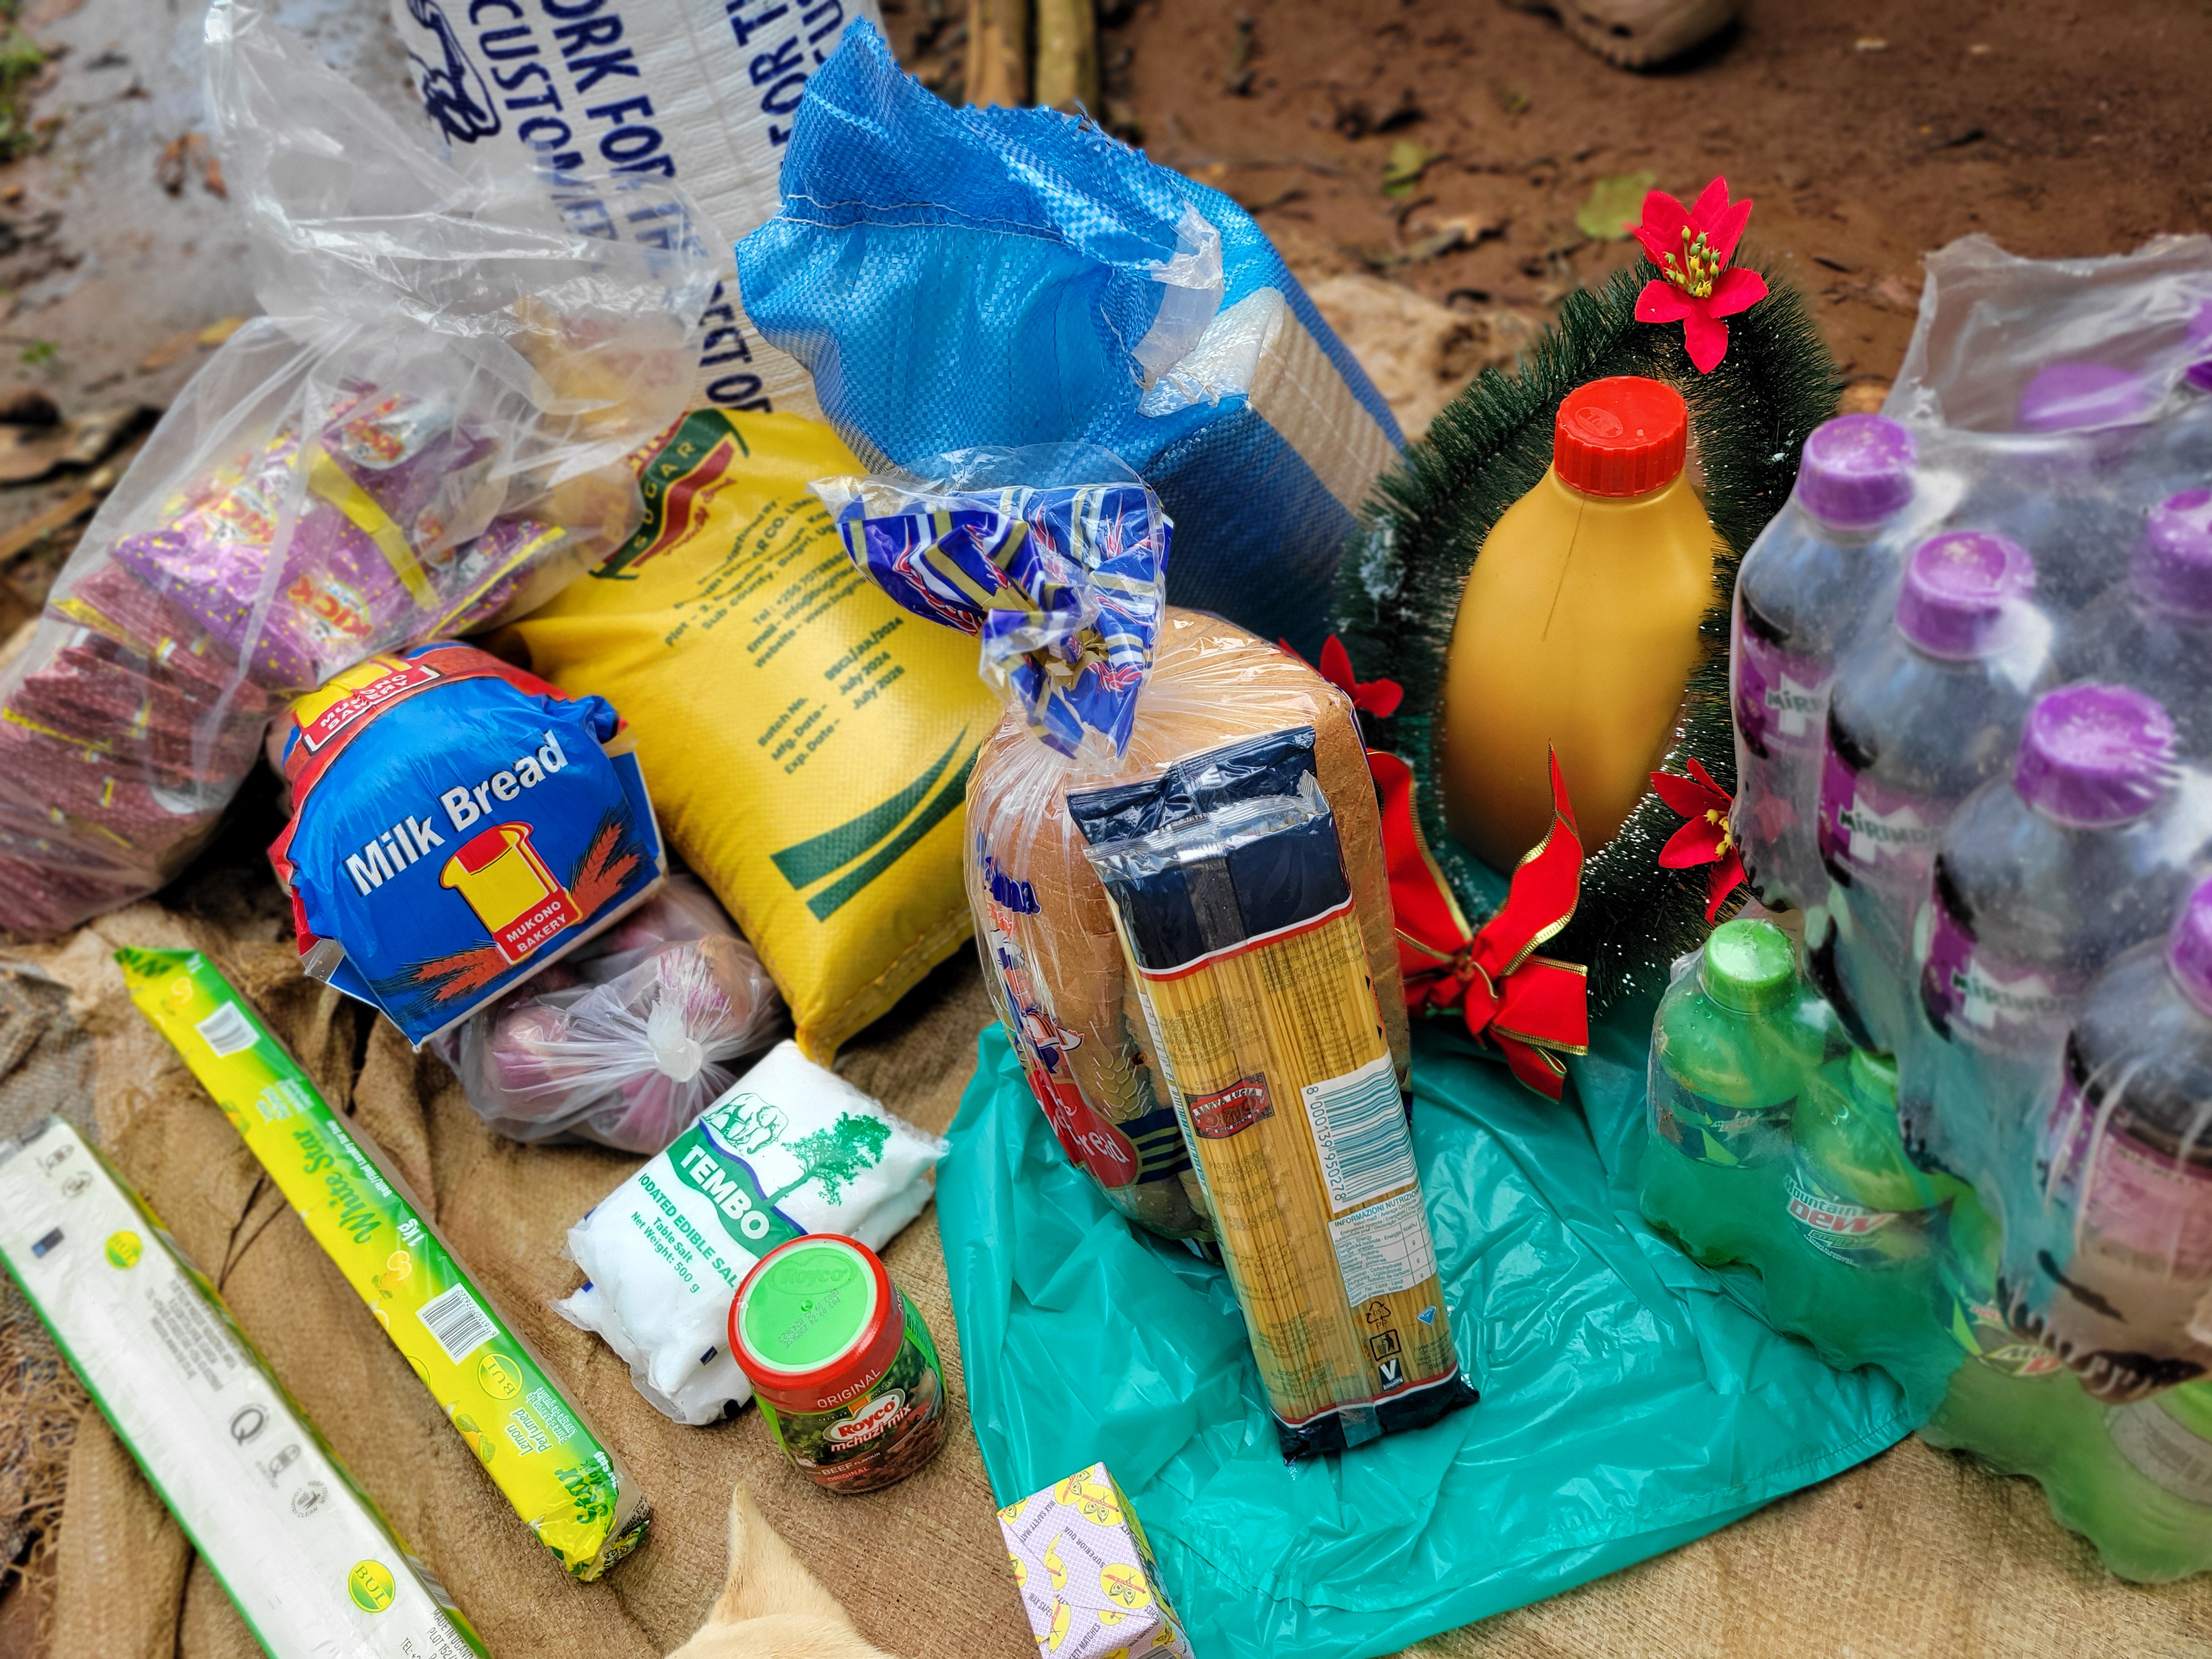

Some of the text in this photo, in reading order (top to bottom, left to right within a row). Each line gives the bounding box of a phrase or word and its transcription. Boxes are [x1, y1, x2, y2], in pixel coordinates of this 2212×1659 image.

[758, 712, 791, 748] Batch
[342, 729, 568, 897] Milk Bread
[505, 900, 562, 943] MUKONO
[516, 913, 568, 953] BAKERY
[1196, 1098, 1227, 1114] SANTA
[1229, 1088, 1257, 1102] LUCIA
[1306, 1085, 1346, 1201] 8 000139 950278
[292, 1127, 382, 1244] White Star
[680, 1144, 770, 1240] TEMBO
[1785, 1173, 1860, 1217] Mountain
[396, 1217, 426, 1248] 1kg
[637, 1172, 741, 1293] IODATED EDIBLE SAL
[1333, 1203, 1385, 1228] INFORMAZIONI
[1789, 1198, 1889, 1233] Dew
[630, 1210, 701, 1294] Net Weight: 500 g
[652, 1216, 693, 1264] Table Salt
[1375, 1319, 1388, 1330] PP
[1379, 1358, 1397, 1382] V
[816, 1368, 881, 1409] ORIGINAL
[510, 1404, 553, 1455] Perfumed
[830, 1402, 912, 1453] mchuzi mix
[837, 1400, 896, 1438] Royco
[503, 1422, 534, 1457] Lemon
[821, 1462, 854, 1476] BEEF
[854, 1452, 881, 1466] FLAVOUR
[826, 1466, 871, 1482] ORIGINAL
[548, 1457, 611, 1530] Star
[296, 1505, 319, 1519] CLEAN
[1031, 1511, 1047, 1531] SAFETY
[1075, 1538, 1106, 1568] SUPERIOR
[426, 1626, 445, 1646] PLOT
[431, 1608, 448, 1632] MADE
[445, 1626, 458, 1640] IN
[1080, 1623, 1101, 1650] MATCHES
[400, 1637, 413, 1656] TEL:
